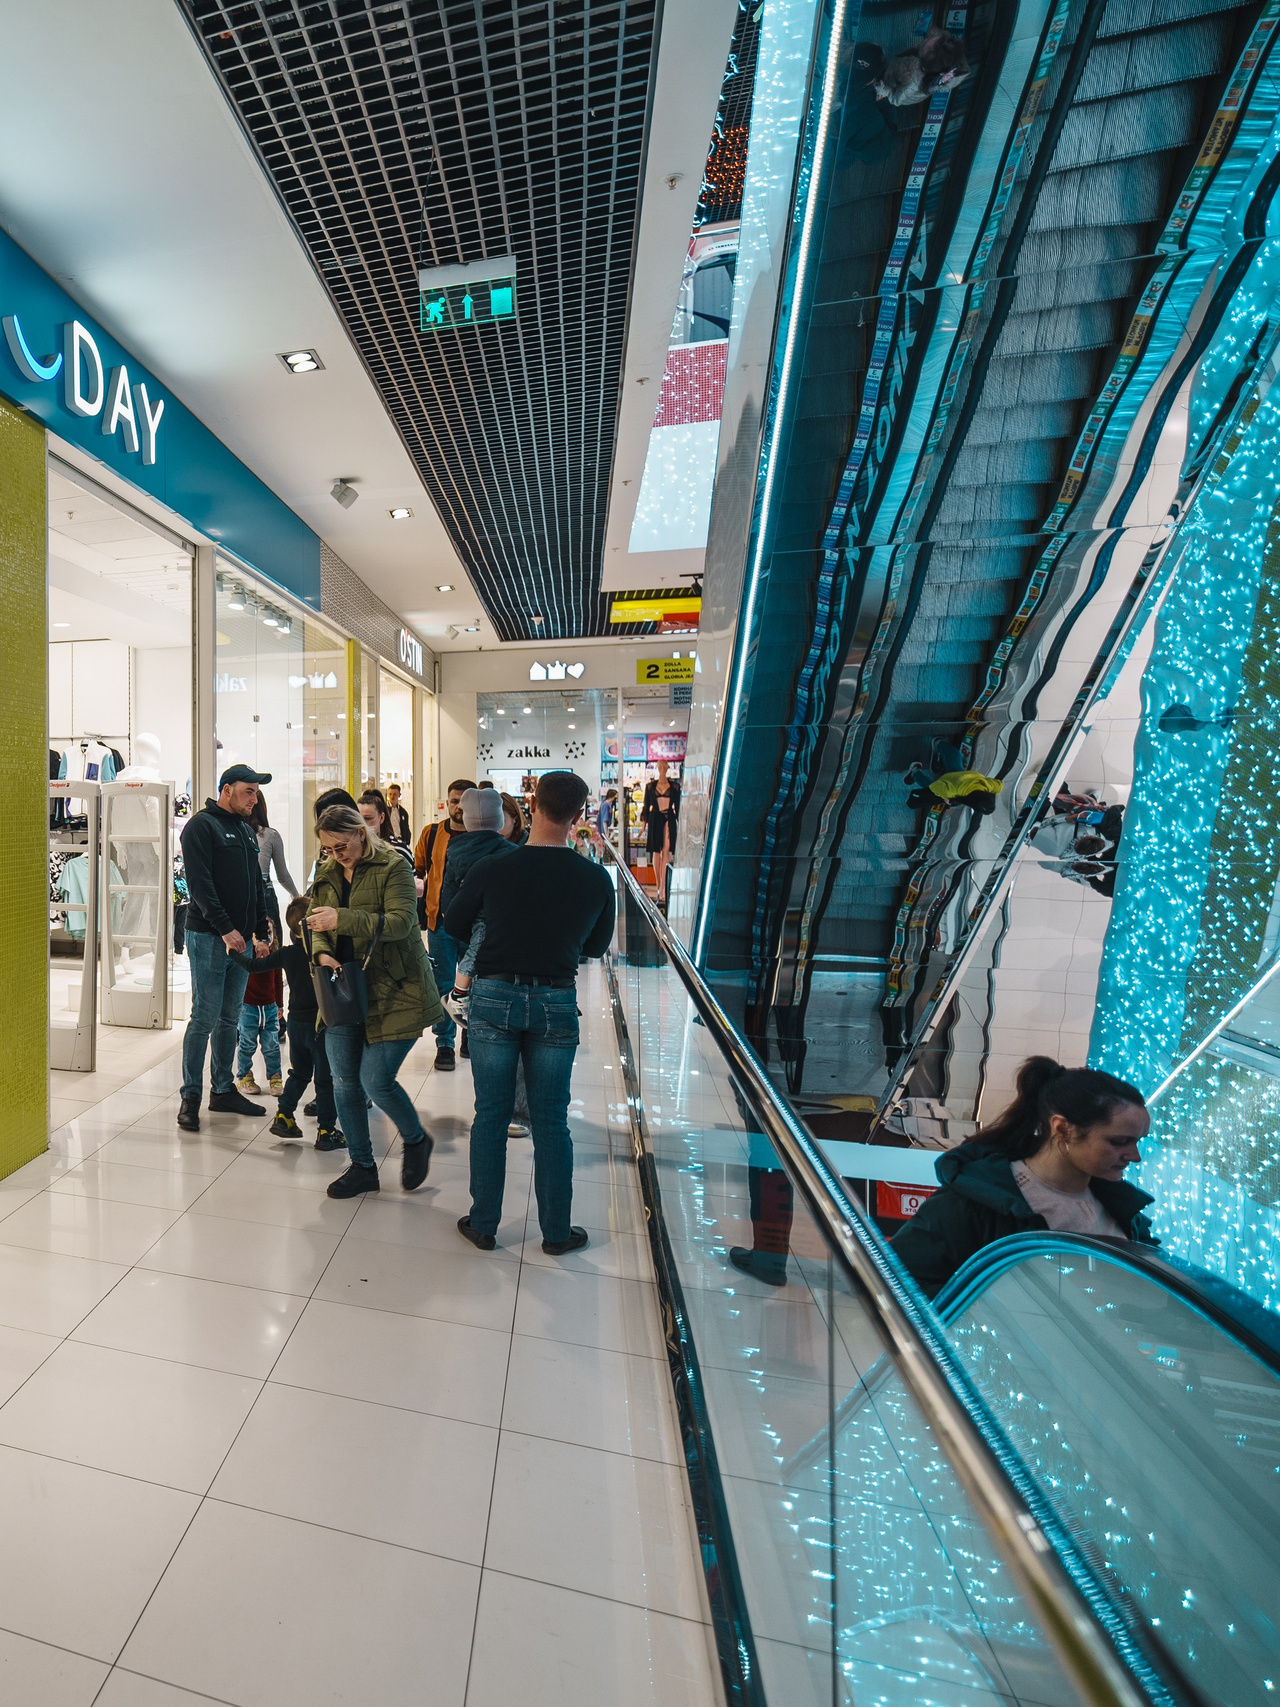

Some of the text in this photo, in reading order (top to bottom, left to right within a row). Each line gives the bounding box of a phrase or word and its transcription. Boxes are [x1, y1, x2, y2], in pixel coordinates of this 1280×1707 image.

[64, 319, 165, 466] DAY
[646, 664, 660, 679] 2
[507, 746, 551, 758] zakka
